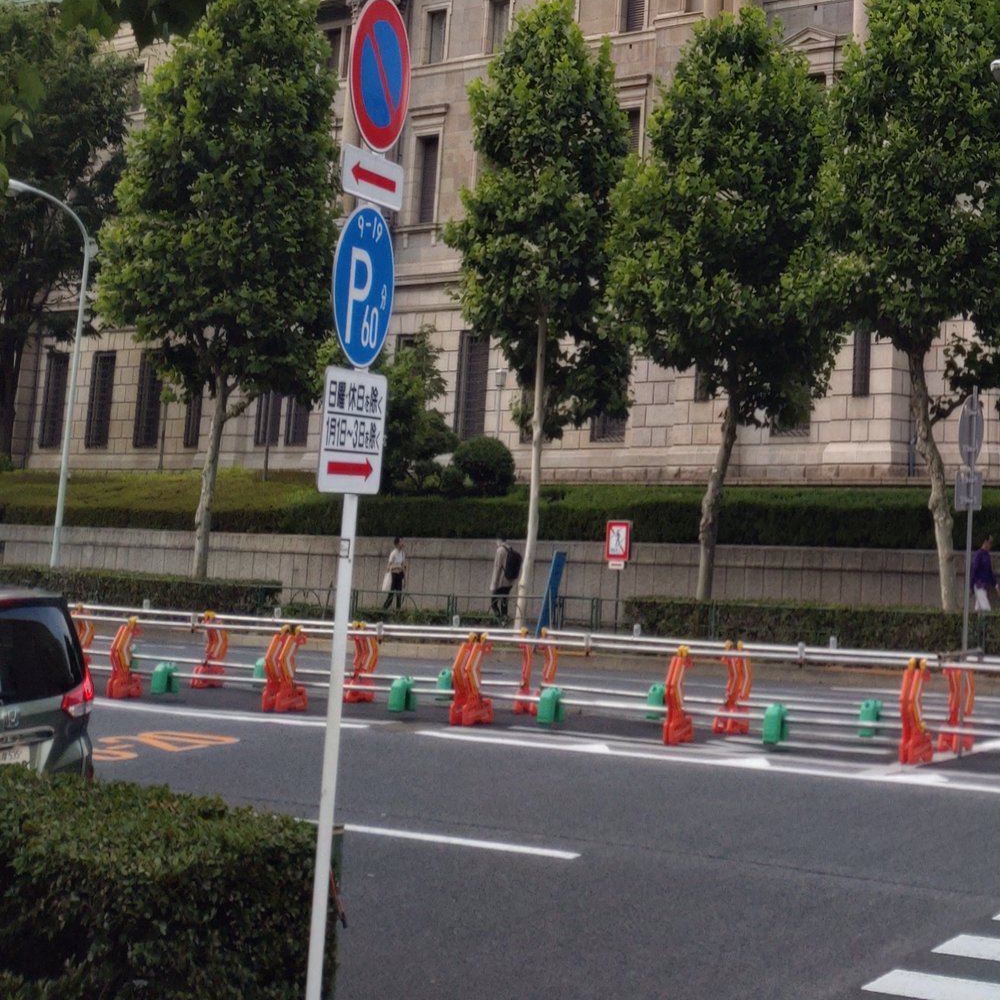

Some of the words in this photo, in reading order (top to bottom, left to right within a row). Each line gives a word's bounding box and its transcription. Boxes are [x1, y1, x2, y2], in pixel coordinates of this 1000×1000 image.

[357, 215, 383, 243] 9-19
[345, 246, 373, 344] P
[380, 284, 387, 311] 分
[361, 304, 379, 349] 60
